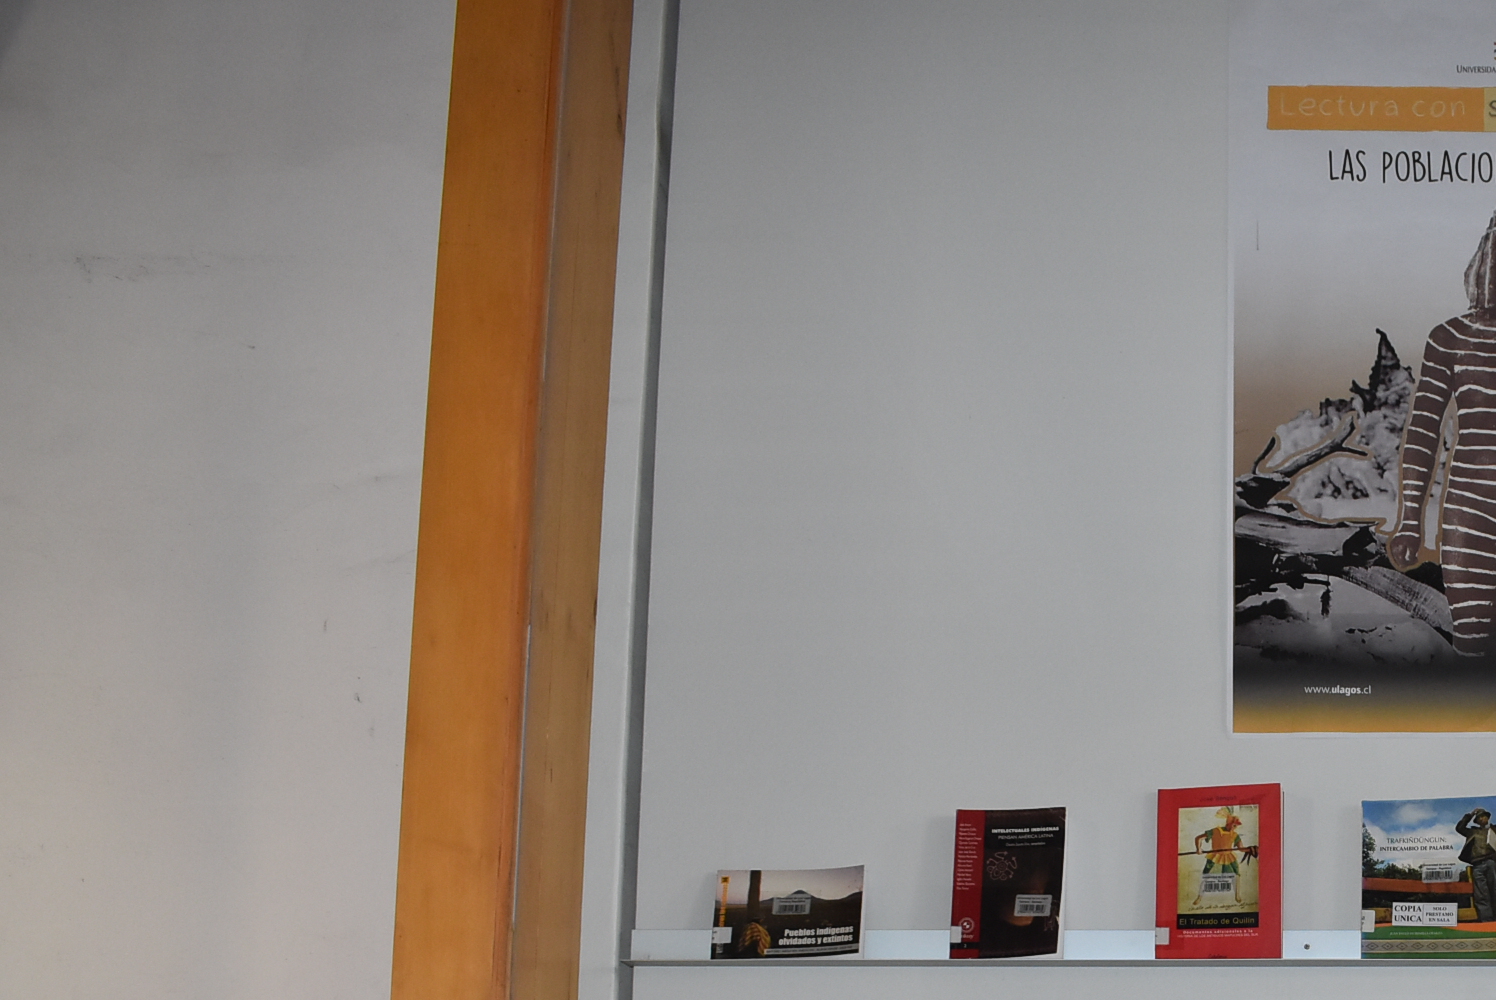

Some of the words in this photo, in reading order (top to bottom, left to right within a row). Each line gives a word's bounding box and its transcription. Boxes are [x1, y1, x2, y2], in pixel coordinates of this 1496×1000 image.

[1279, 95, 1400, 117] Lectura
[1411, 100, 1466, 117] con
[1327, 149, 1367, 184] LAS
[1304, 684, 1371, 697] www.ulagos.cl
